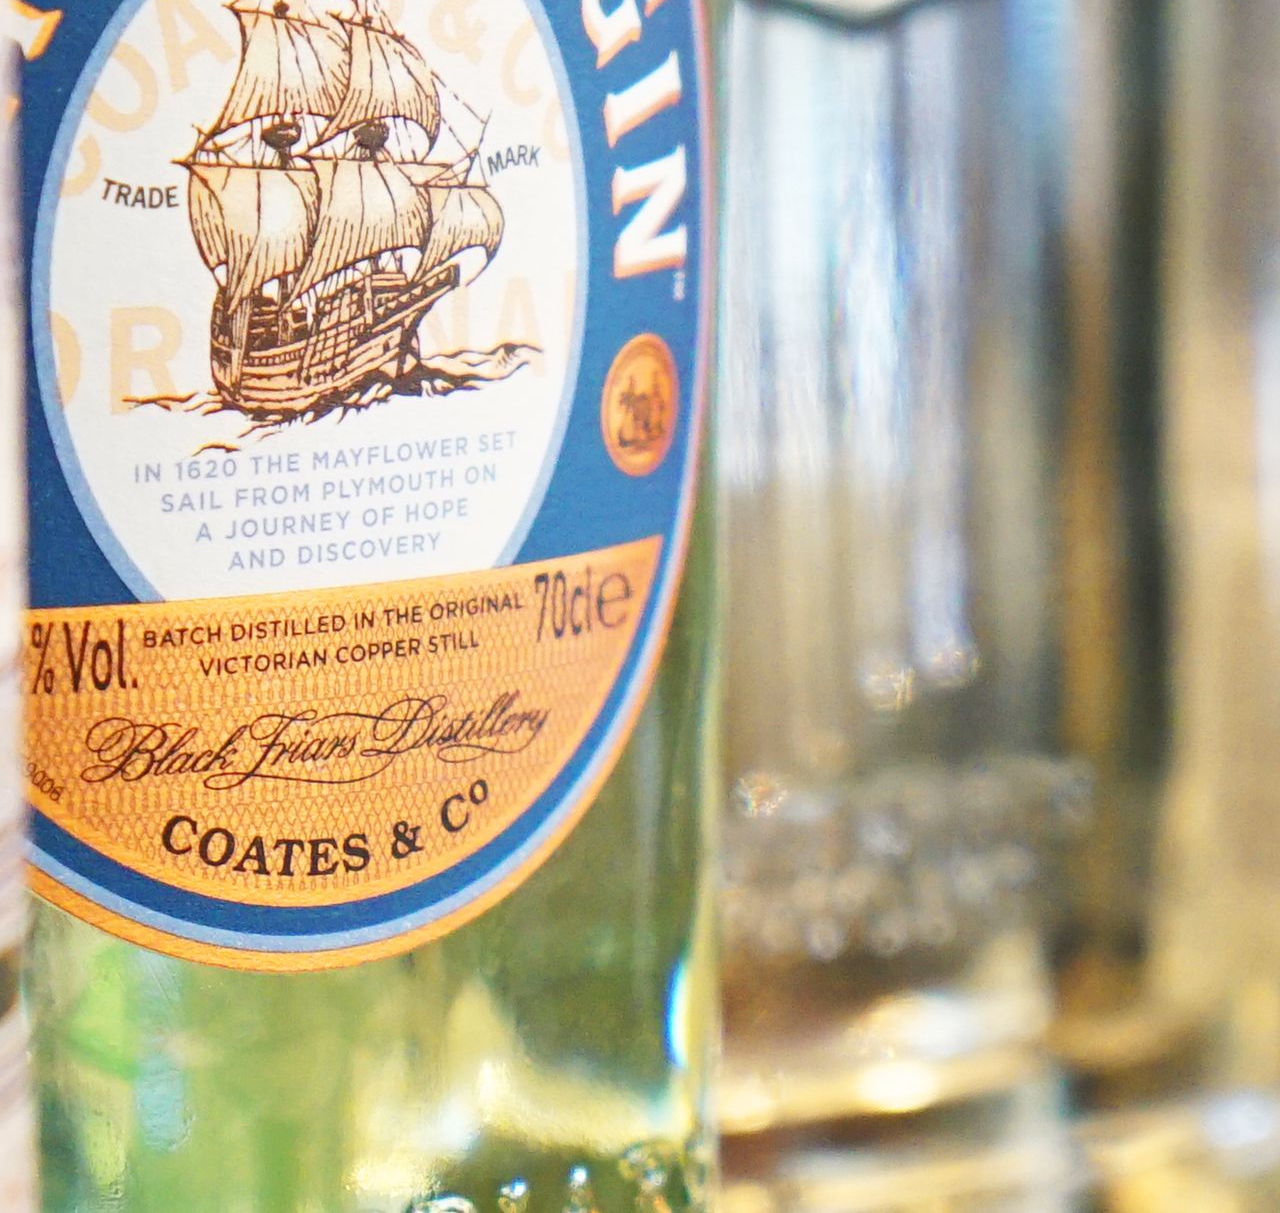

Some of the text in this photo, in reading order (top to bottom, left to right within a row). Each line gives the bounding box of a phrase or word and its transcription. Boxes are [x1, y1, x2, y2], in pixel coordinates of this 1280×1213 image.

[487, 145, 542, 178] MARK
[101, 178, 180, 210] TRADE
[134, 430, 517, 484] IN 1620 THE MAYFLOWER SET
[161, 463, 497, 513] SAIL FROM PLYMOUTH ON
[196, 497, 469, 543] A JOURNEY OF HOPE
[228, 532, 442, 571] AND DISCOVERY
[143, 592, 525, 649] BATCH DISTILLED IN THE ORIGINAL
[199, 629, 480, 677] VICTORIAN COPPER STILL
[79, 689, 553, 791] Black Friars Distillery
[162, 814, 371, 877] COATES
[390, 819, 425, 859] &
